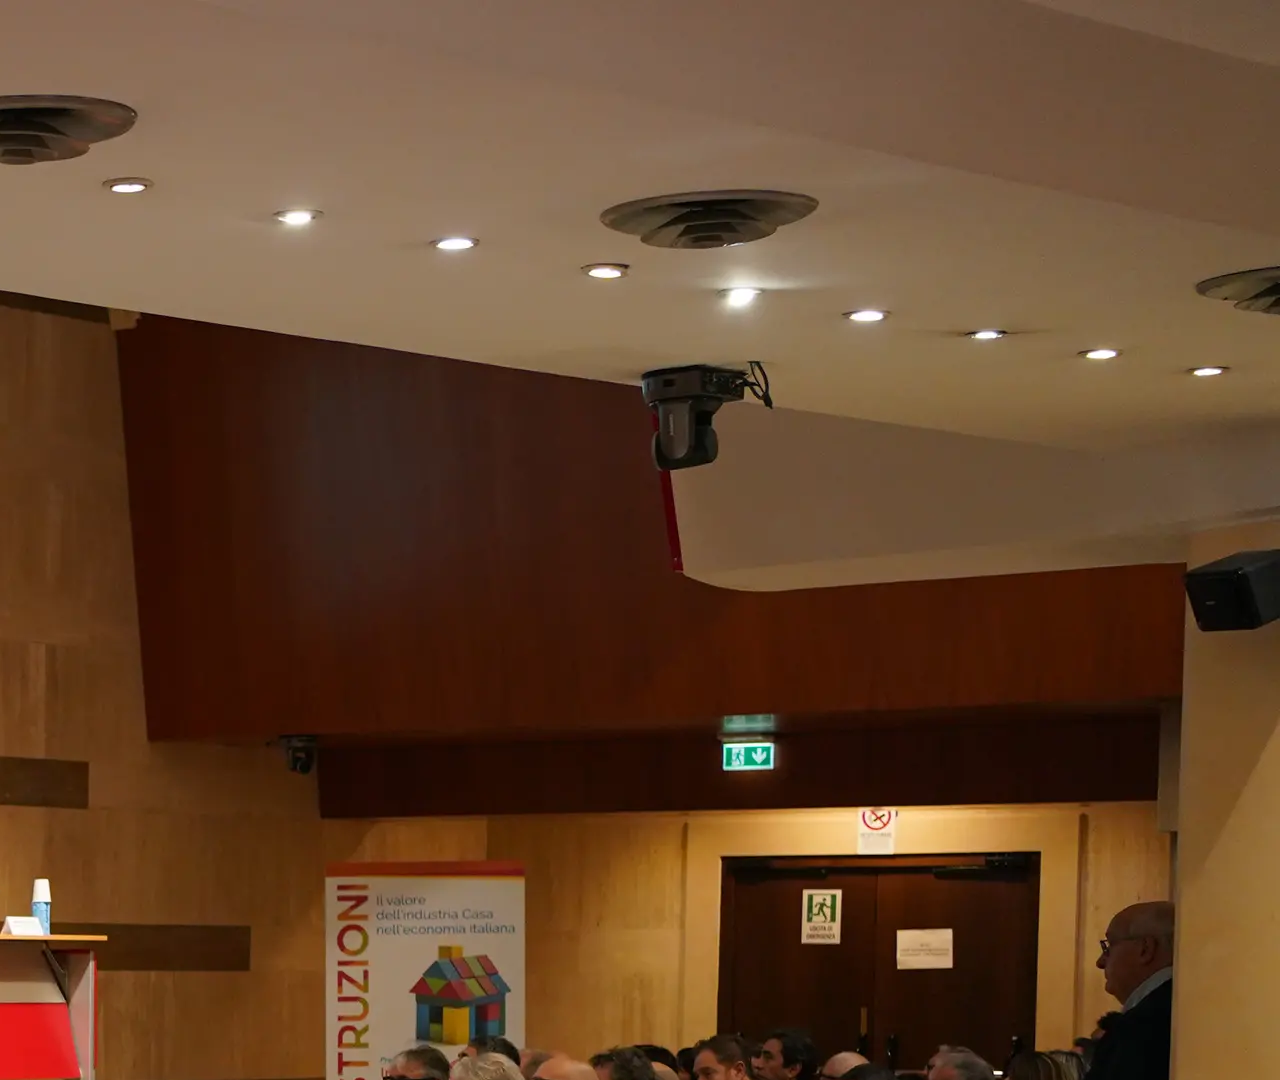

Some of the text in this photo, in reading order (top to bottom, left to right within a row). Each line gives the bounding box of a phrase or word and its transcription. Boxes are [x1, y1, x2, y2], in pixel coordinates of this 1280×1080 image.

[376, 895, 426, 906] Il valore
[376, 909, 494, 921] dell'industria Casa
[376, 923, 516, 935] nell'economia italiana
